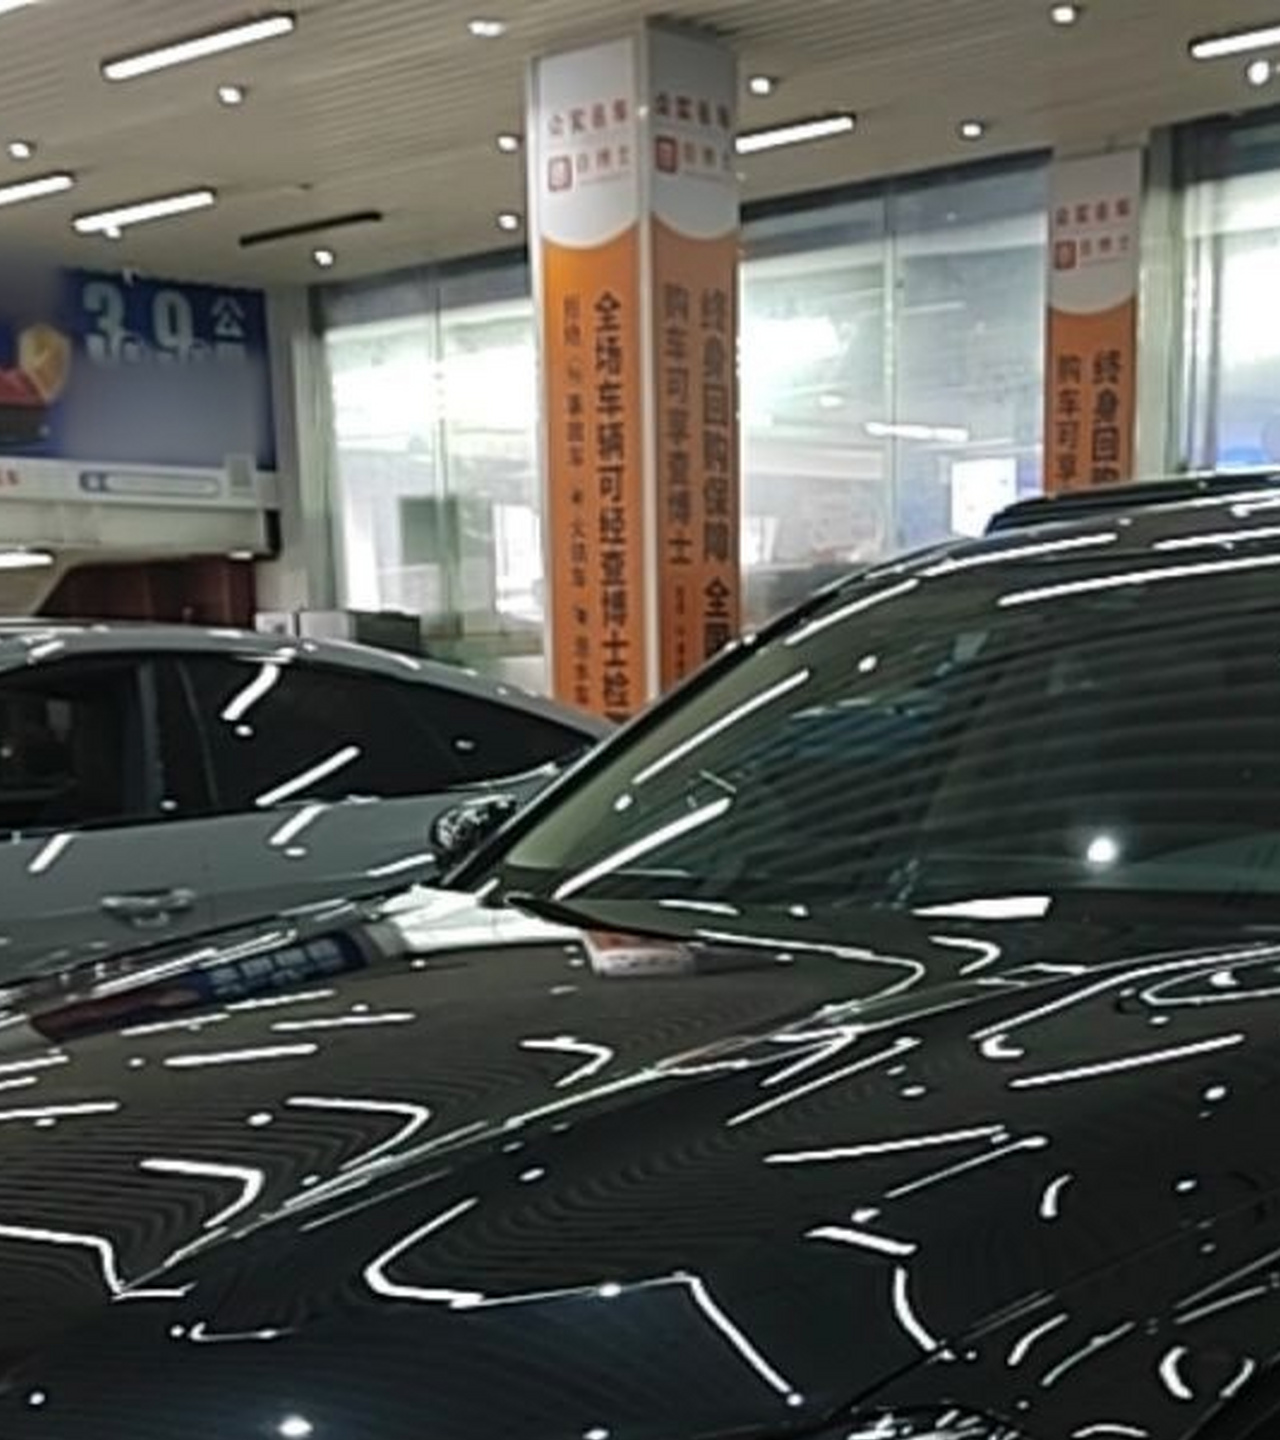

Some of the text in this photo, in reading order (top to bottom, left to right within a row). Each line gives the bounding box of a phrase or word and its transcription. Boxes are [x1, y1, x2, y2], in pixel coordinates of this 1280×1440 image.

[594, 292, 630, 723] 全场车辆可经查博士检
